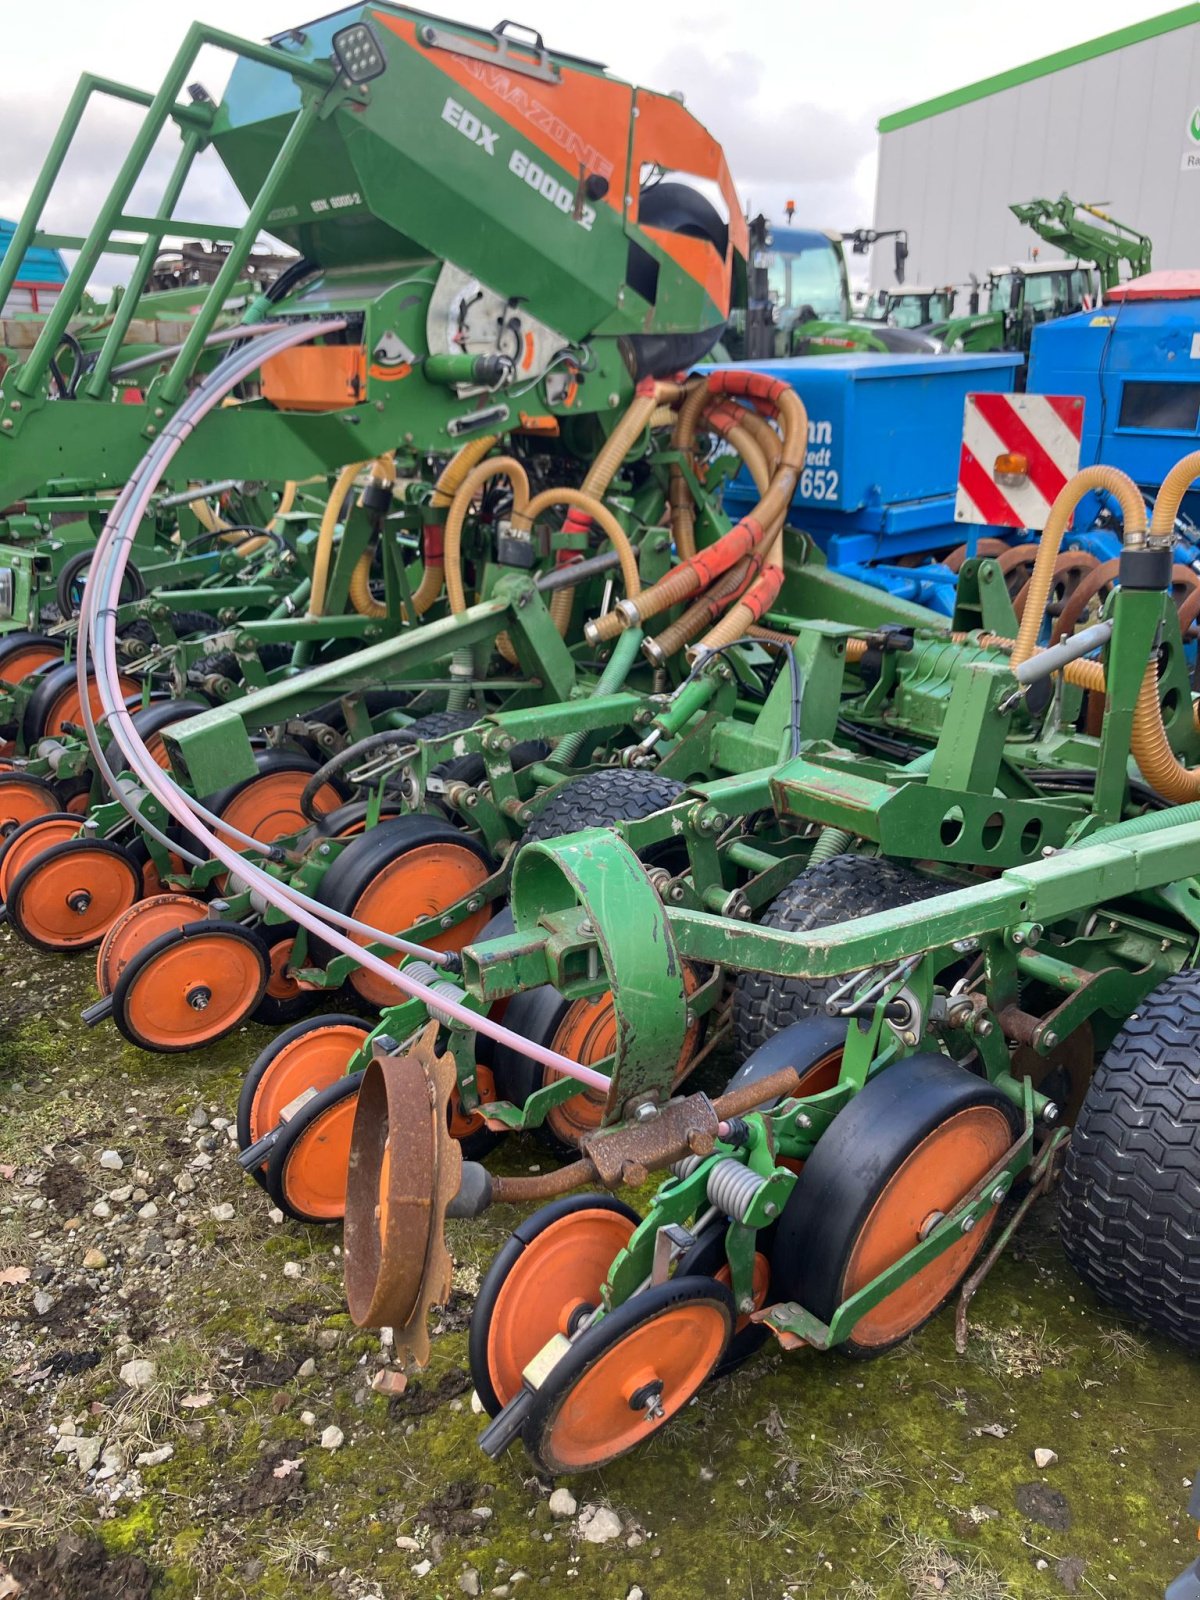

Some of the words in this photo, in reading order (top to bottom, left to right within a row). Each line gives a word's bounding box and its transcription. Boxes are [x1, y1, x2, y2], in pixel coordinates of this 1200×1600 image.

[441, 97, 499, 156] EDX
[508, 149, 597, 232] 6000-2
[800, 469, 839, 501] 652
